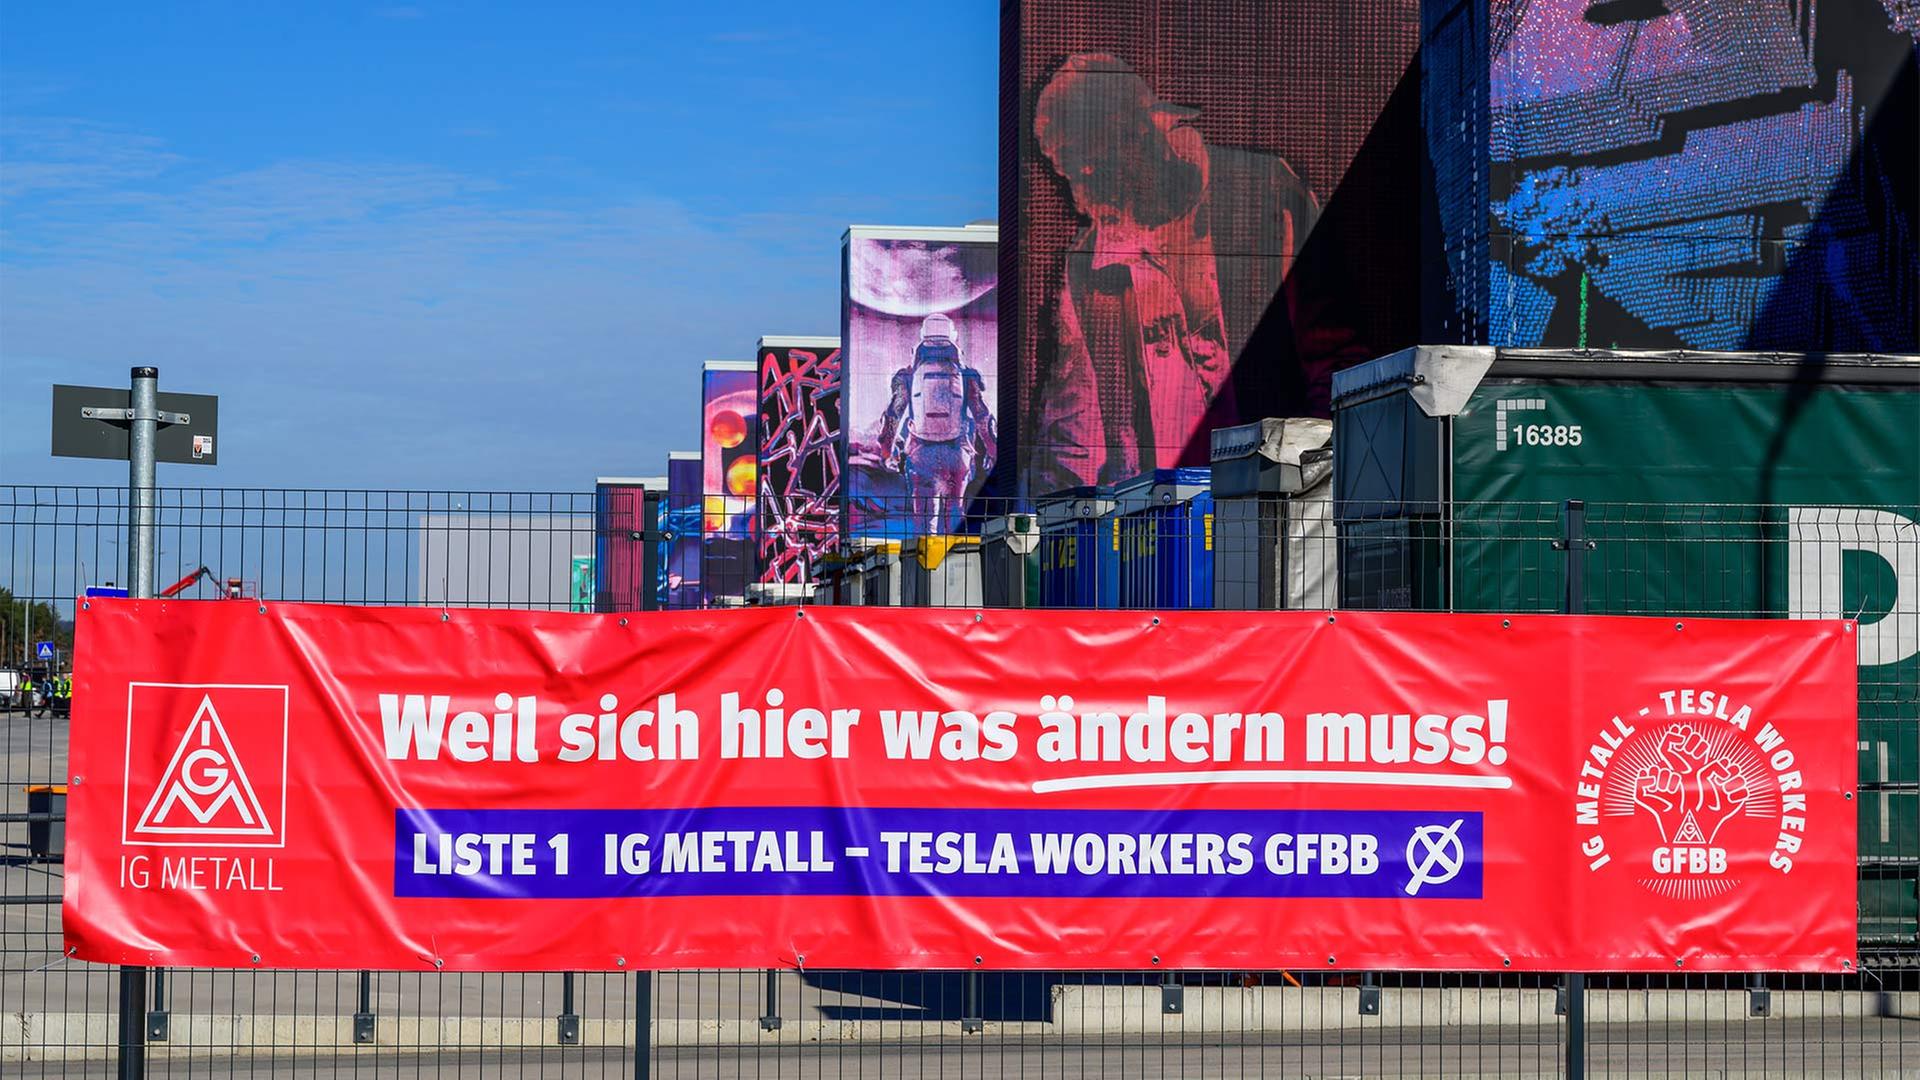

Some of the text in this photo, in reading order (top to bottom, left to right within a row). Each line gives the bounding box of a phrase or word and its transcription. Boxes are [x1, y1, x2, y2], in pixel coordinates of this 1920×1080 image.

[1513, 424, 1583, 446] 16385
[379, 689, 1509, 766] Weil sich hier was ändern muss!
[1659, 689, 1752, 731] TESLA
[1576, 715, 1636, 825] METALL
[1754, 721, 1806, 874] WORKERS
[120, 855, 284, 891] IG METALL
[413, 832, 536, 876] LISTE
[548, 833, 568, 875] 1
[604, 832, 651, 875] IG
[660, 831, 834, 874] METALL
[881, 831, 1020, 874] TESLA
[1030, 833, 1253, 875] WORKERS
[1265, 833, 1379, 875] GFBB
[1582, 835, 1611, 872] IG
[1652, 847, 1728, 874] GFBB
